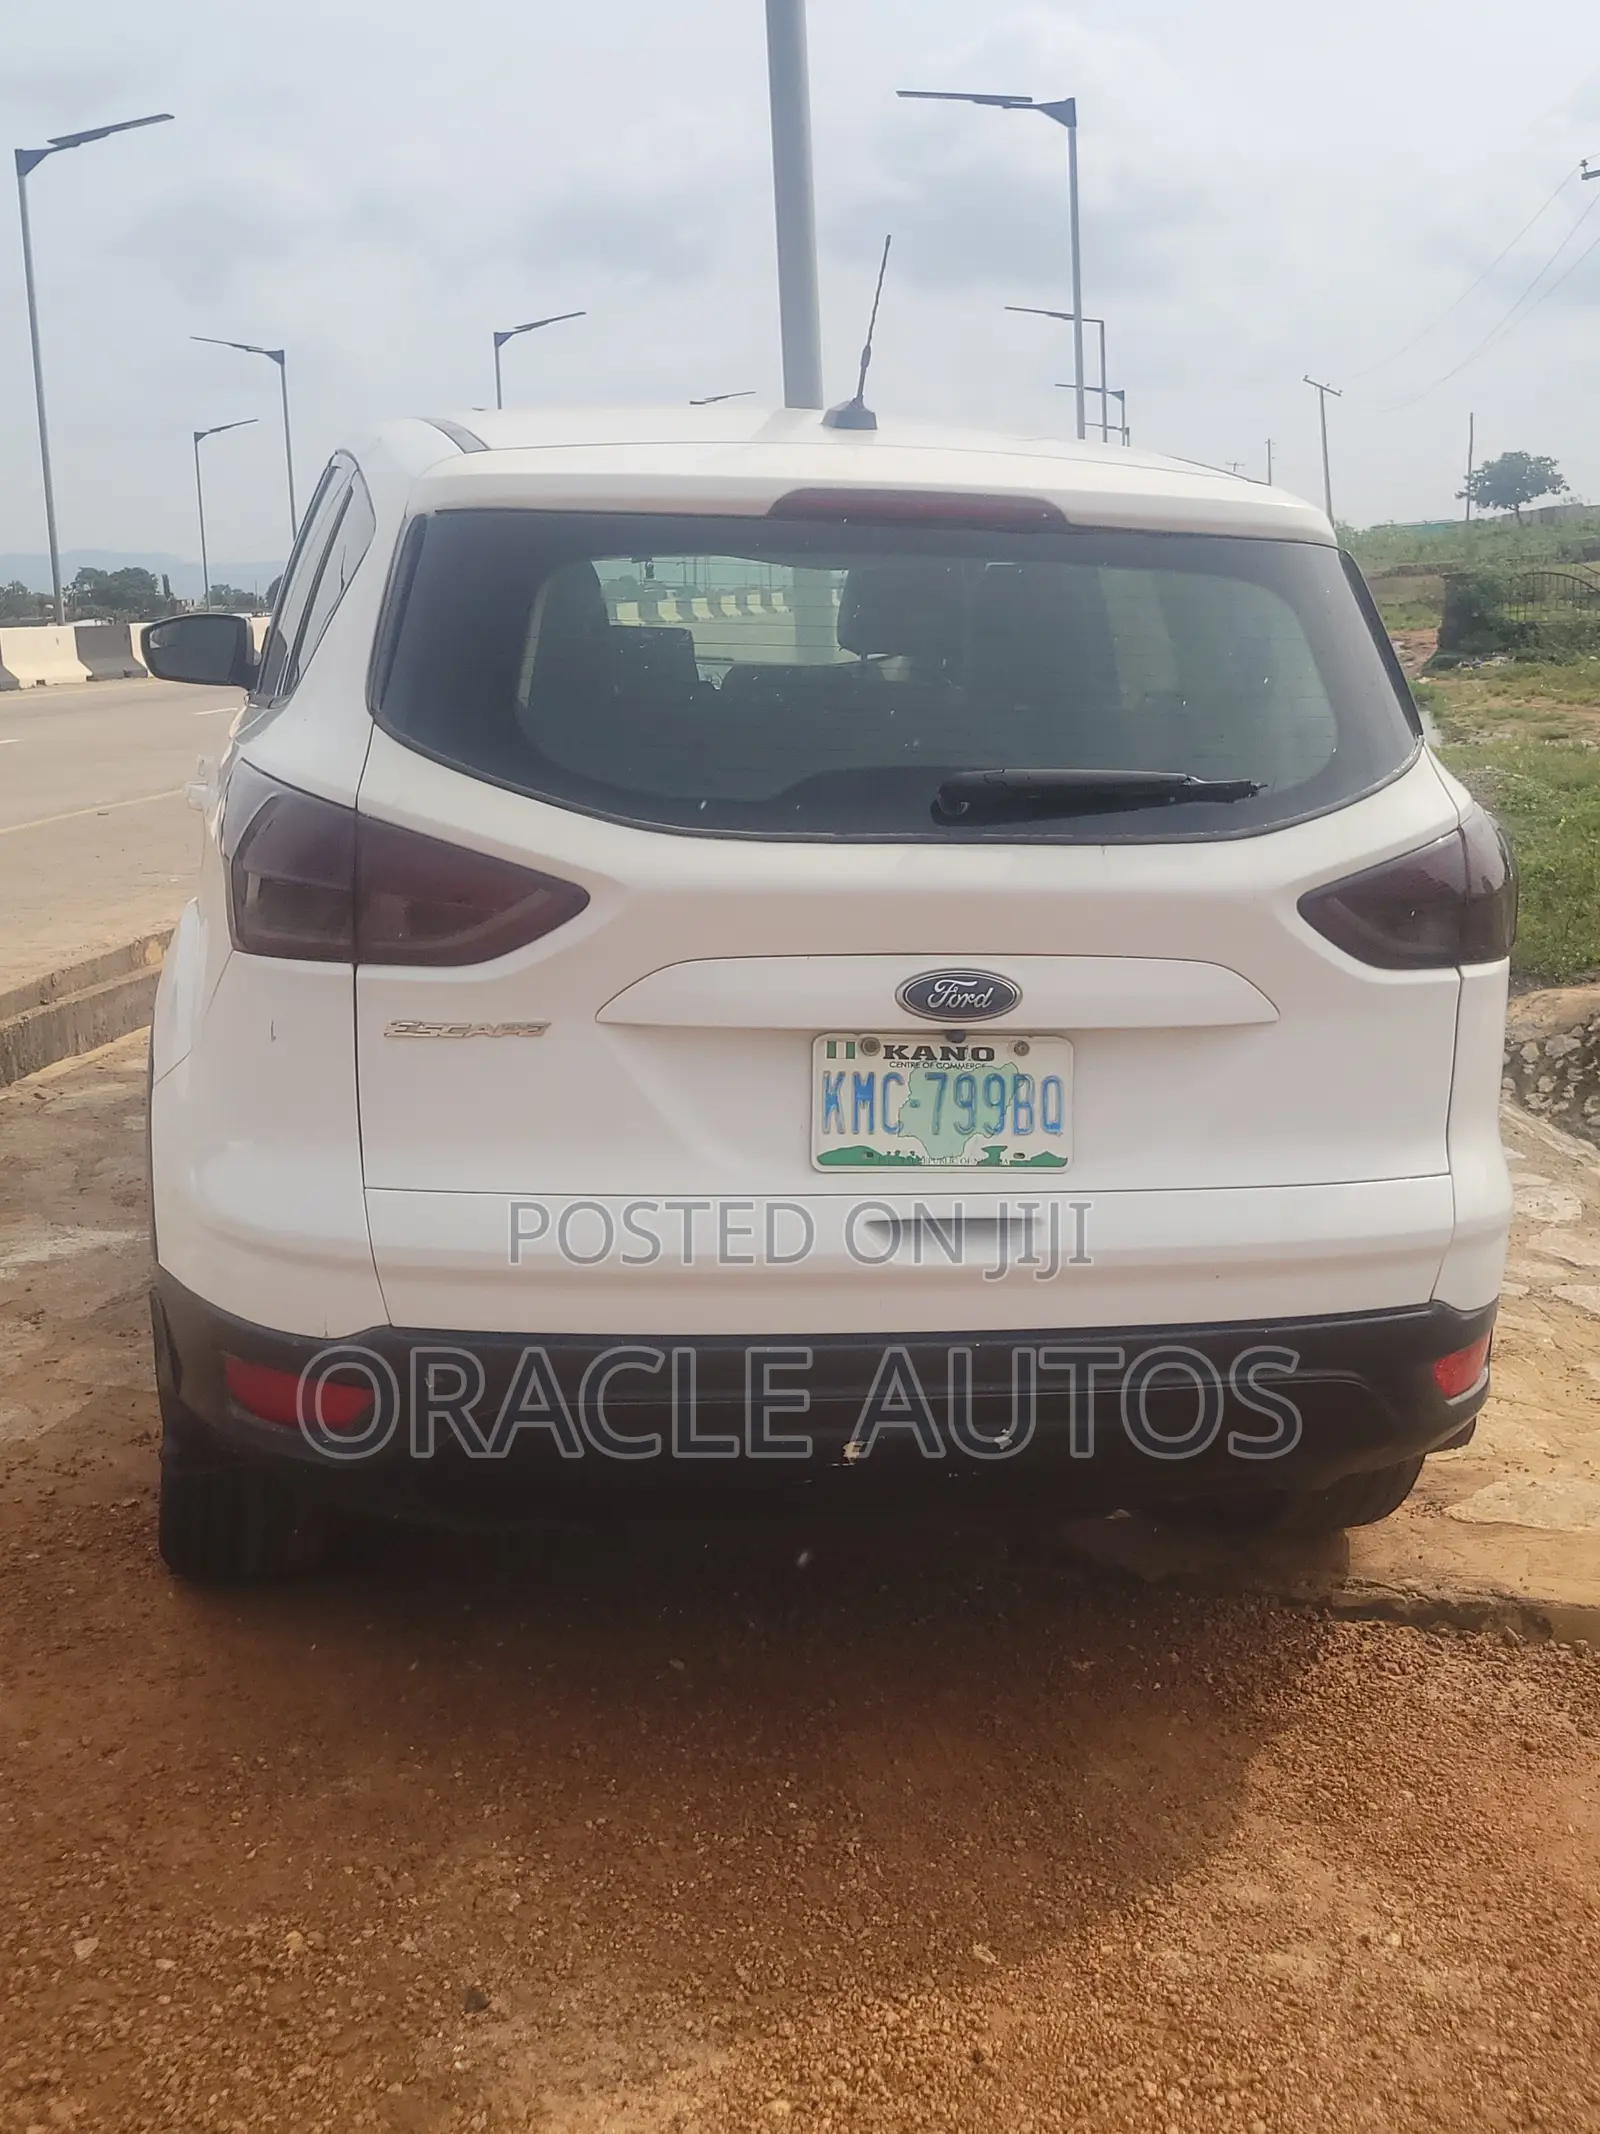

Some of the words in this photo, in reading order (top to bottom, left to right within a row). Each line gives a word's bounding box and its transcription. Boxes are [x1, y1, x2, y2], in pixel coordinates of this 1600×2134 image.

[927, 979, 994, 1009] Ford
[883, 1045, 995, 1062] KANO
[889, 1061, 921, 1069] CENTRE
